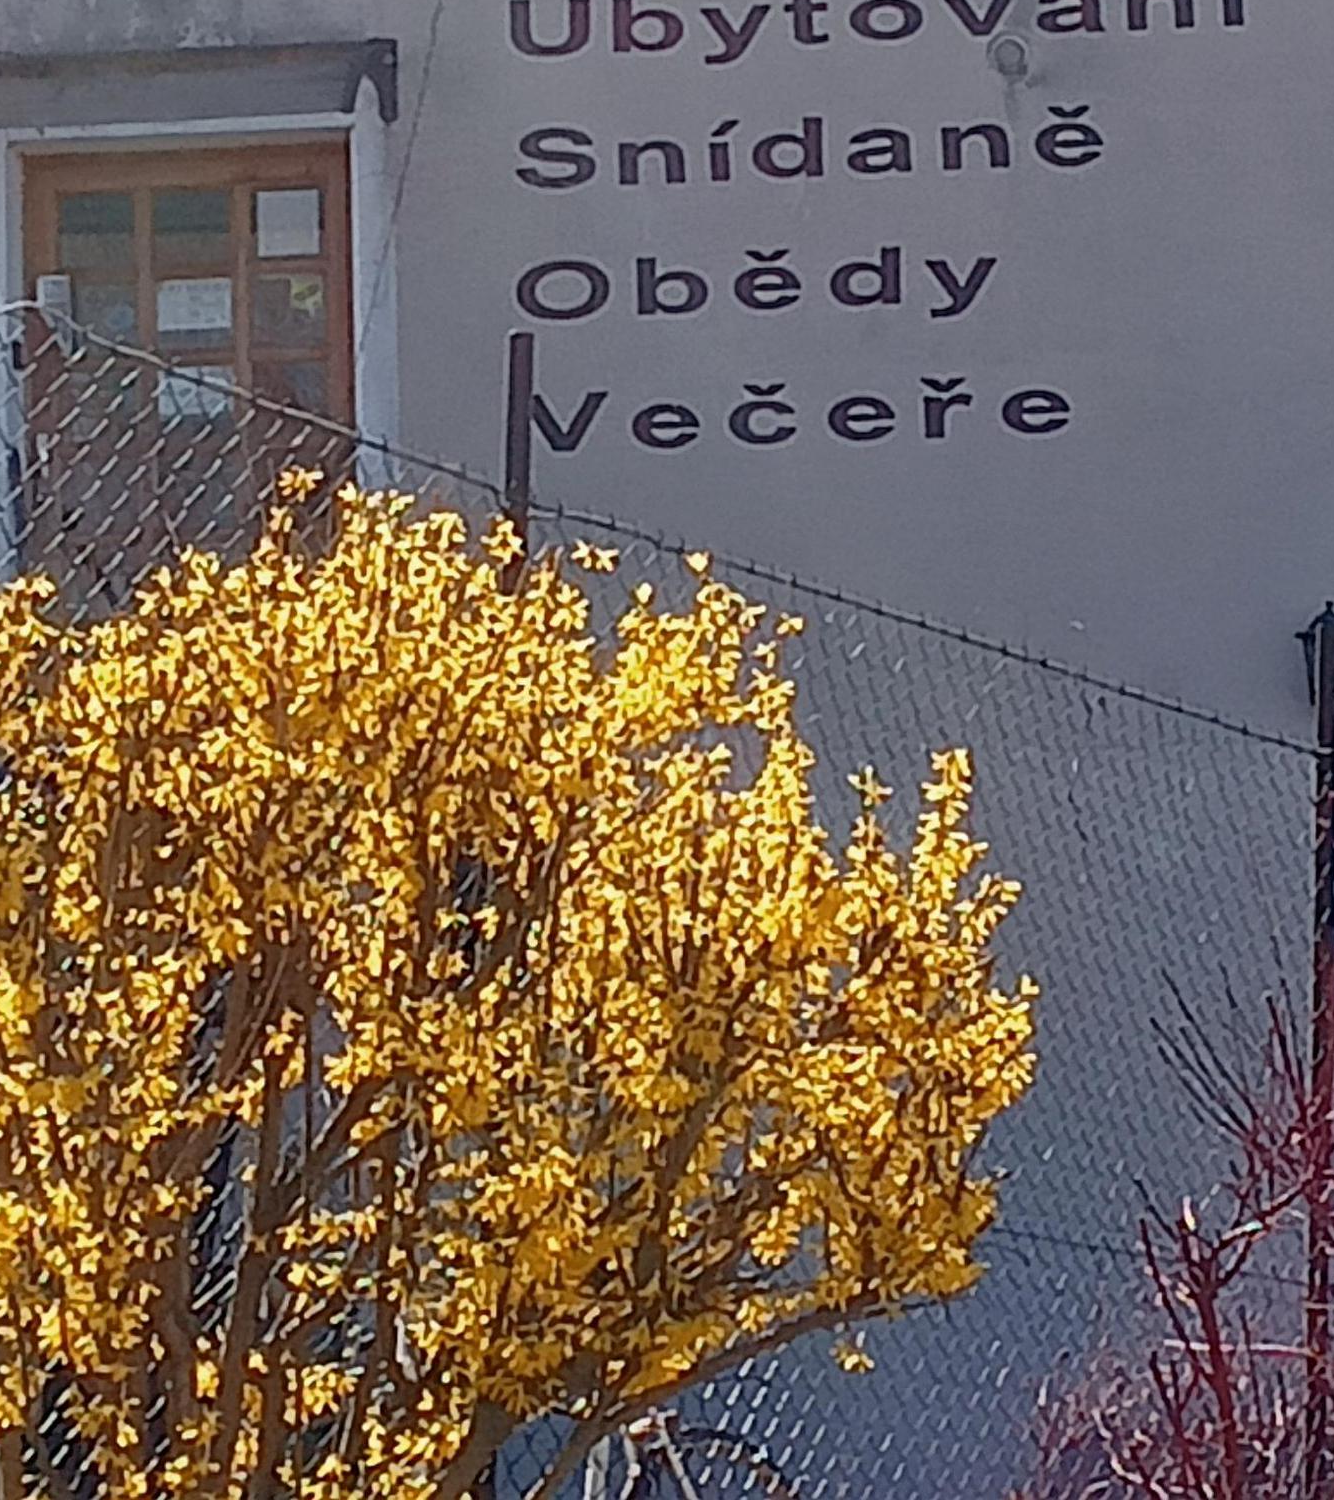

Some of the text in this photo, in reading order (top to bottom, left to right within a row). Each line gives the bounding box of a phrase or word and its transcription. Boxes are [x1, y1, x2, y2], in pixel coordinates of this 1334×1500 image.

[515, 105, 1103, 189] Snídaně
[516, 247, 996, 320] Obědy
[528, 376, 1071, 452] Večeře
